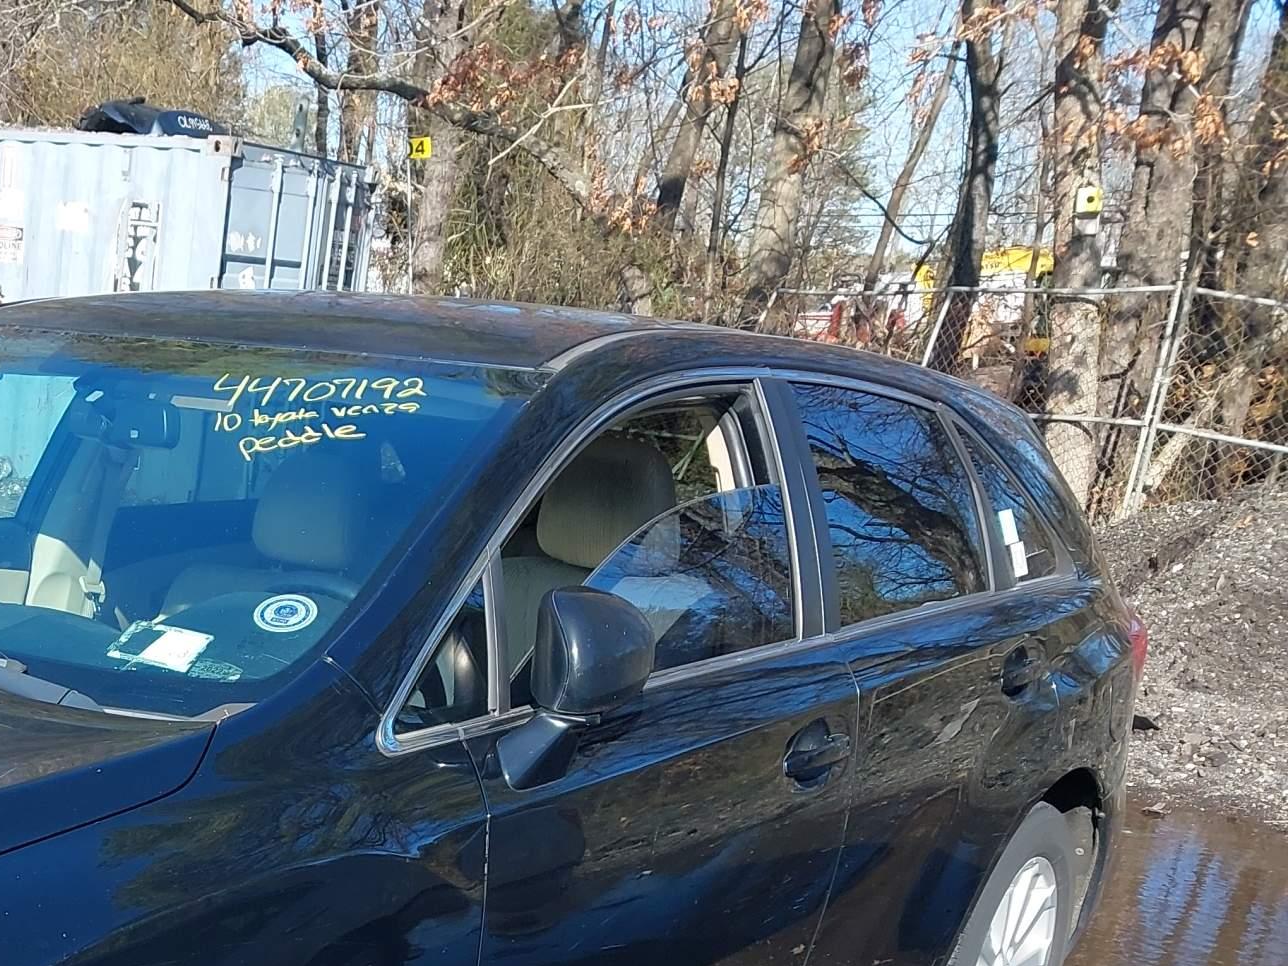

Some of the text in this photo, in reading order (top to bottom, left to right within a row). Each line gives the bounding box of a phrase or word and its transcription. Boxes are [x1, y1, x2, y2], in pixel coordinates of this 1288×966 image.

[213, 373, 427, 406] 44707192
[214, 412, 242, 432] 10
[238, 423, 367, 461] peddle
